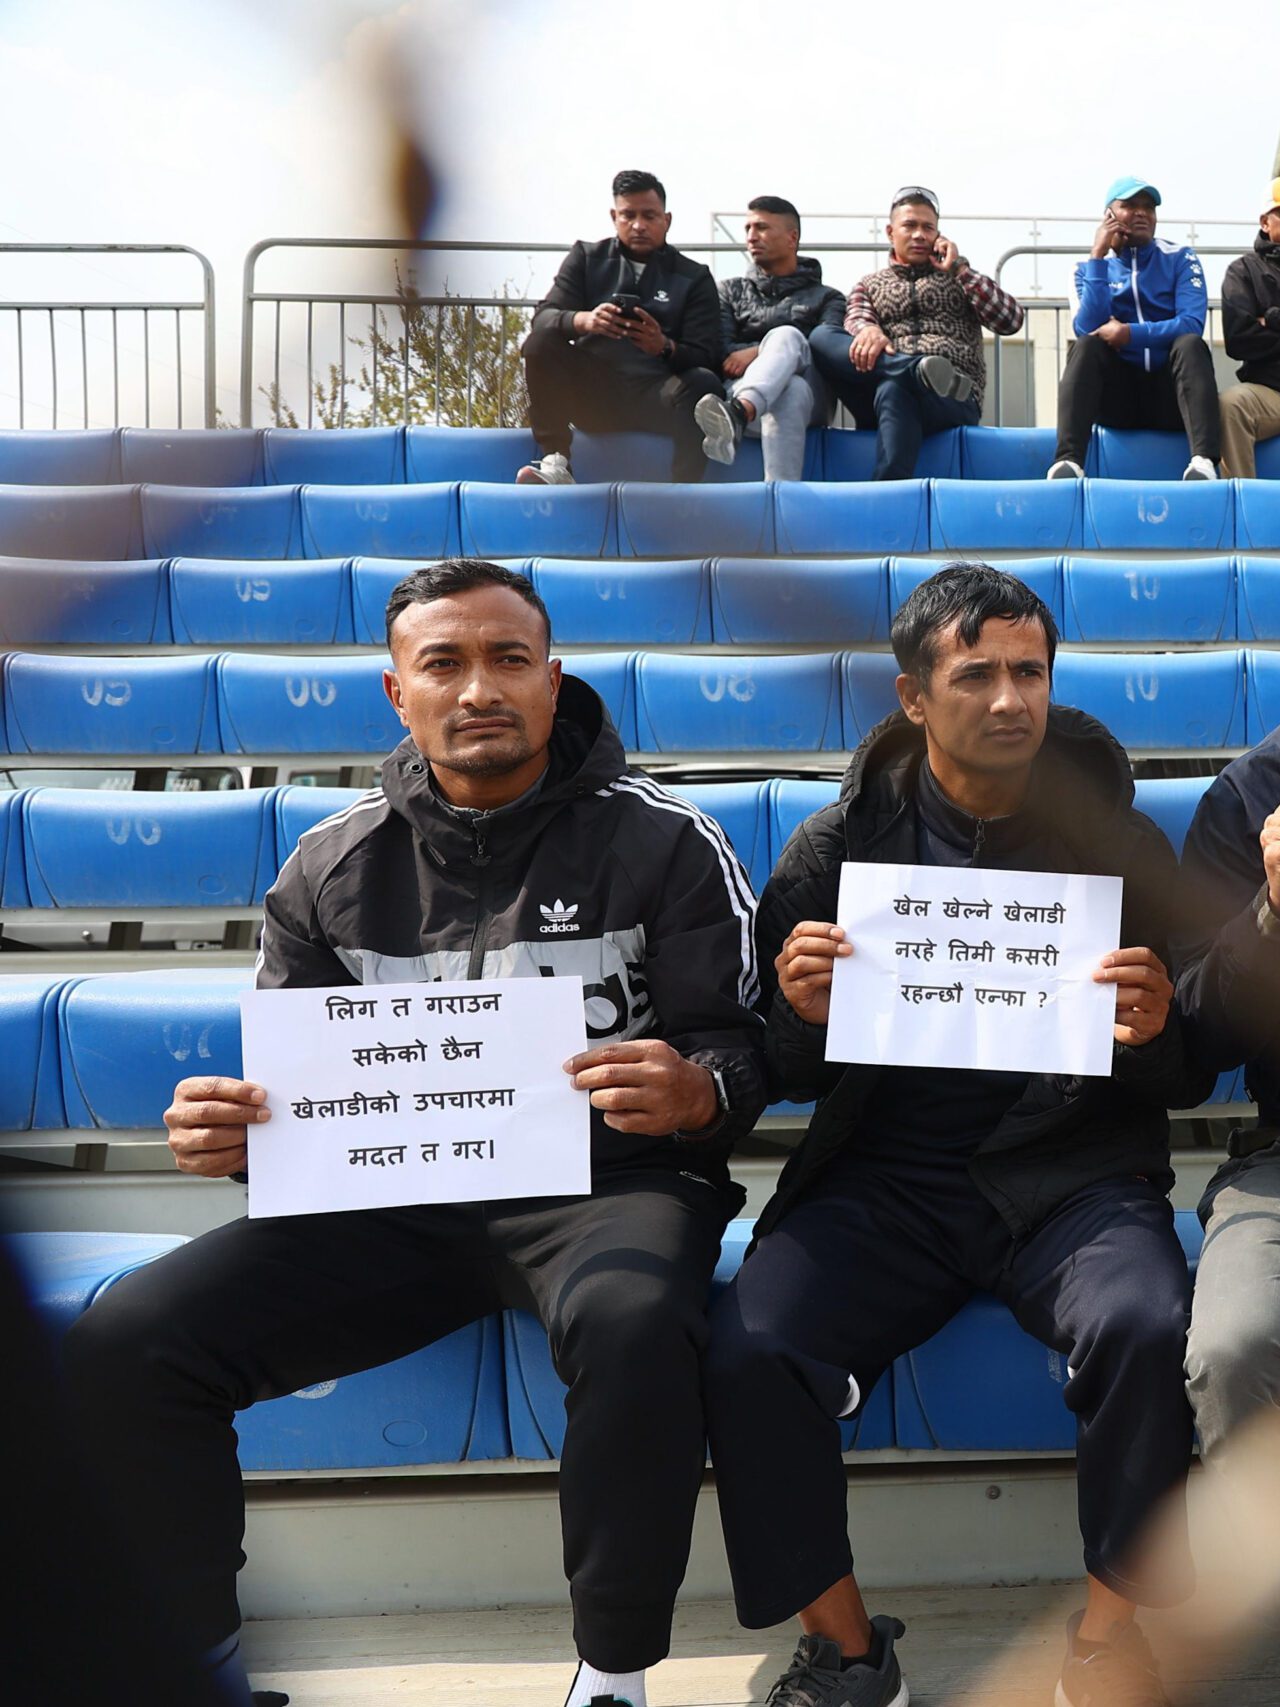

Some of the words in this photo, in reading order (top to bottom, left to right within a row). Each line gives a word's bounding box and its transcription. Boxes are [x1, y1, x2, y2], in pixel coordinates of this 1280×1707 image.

[893, 894, 932, 917] खेल
[942, 897, 993, 920] खेल्ने
[1003, 900, 1067, 924] खेलाडी
[539, 922, 580, 934] adidas
[895, 937, 938, 962] नरहे
[947, 938, 996, 963] तिमी
[1006, 944, 1060, 967] कसरी
[325, 995, 378, 1021] लिग
[390, 998, 412, 1018] त
[424, 993, 503, 1015] गराउन
[900, 981, 964, 1005] रहन्छौ
[974, 988, 1027, 1007] एन्फा
[1038, 991, 1047, 1008] ?
[351, 1038, 428, 1068] सकेको
[440, 1035, 484, 1061] छैन
[290, 1089, 401, 1119] खेलाडीको
[412, 1088, 516, 1112] उपचारमा
[347, 1145, 408, 1167] मदत
[420, 1143, 440, 1163] त
[451, 1139, 495, 1160] गर।
